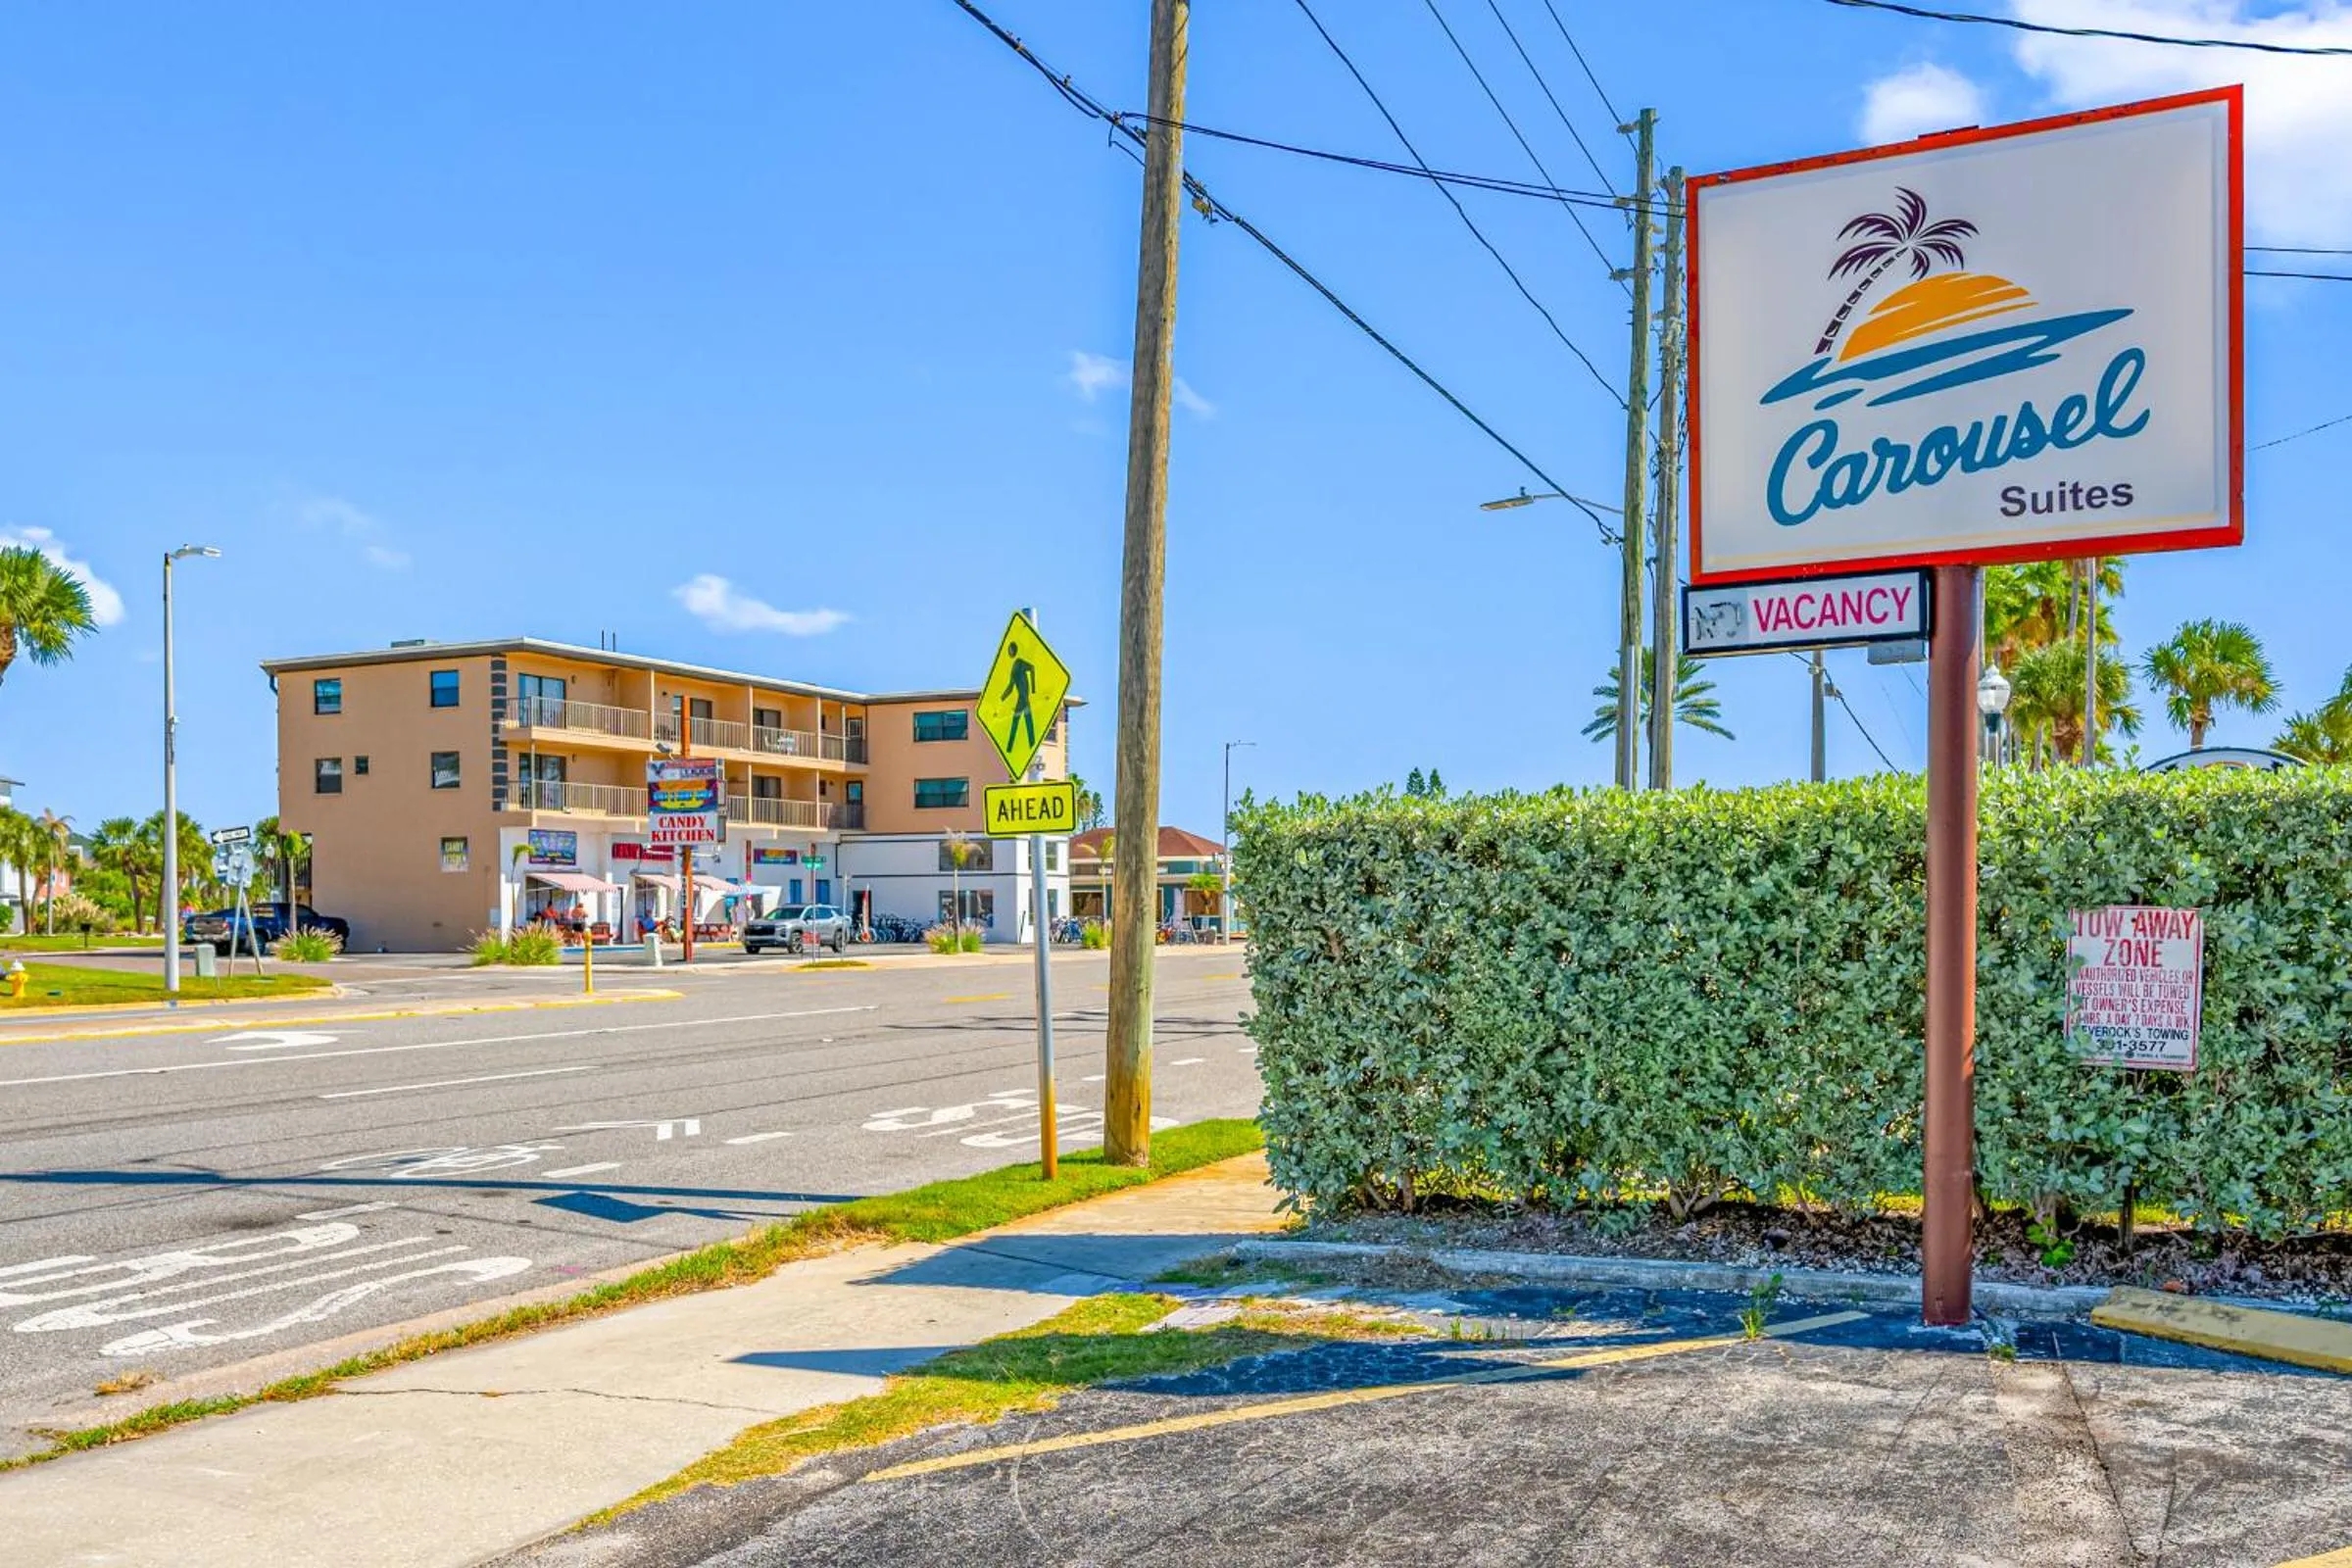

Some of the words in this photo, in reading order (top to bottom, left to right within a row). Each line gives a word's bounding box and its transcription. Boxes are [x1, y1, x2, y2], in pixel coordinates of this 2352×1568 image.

[1767, 347, 2150, 526] Carousel
[1999, 481, 2134, 517] Suites
[1752, 587, 1913, 634] VACANCY
[658, 815, 707, 829] CANDY
[997, 796, 1064, 823] AHEAD
[651, 829, 714, 842] KITCHEN
[2076, 909, 2125, 938] TOW
[2132, 909, 2195, 941] AWAY
[2103, 938, 2164, 968] ZONE
[2118, 983, 2140, 999] WILL
[2142, 984, 2156, 999] BE
[2158, 984, 2190, 1001] TOWED
[2115, 1013, 2131, 1027] DAY
[2141, 1014, 2164, 1029] DAYS
[2140, 999, 2187, 1016] EXPENSE
[2146, 1026, 2189, 1042] TOWING
[0, 1222, 534, 1357] BUS
